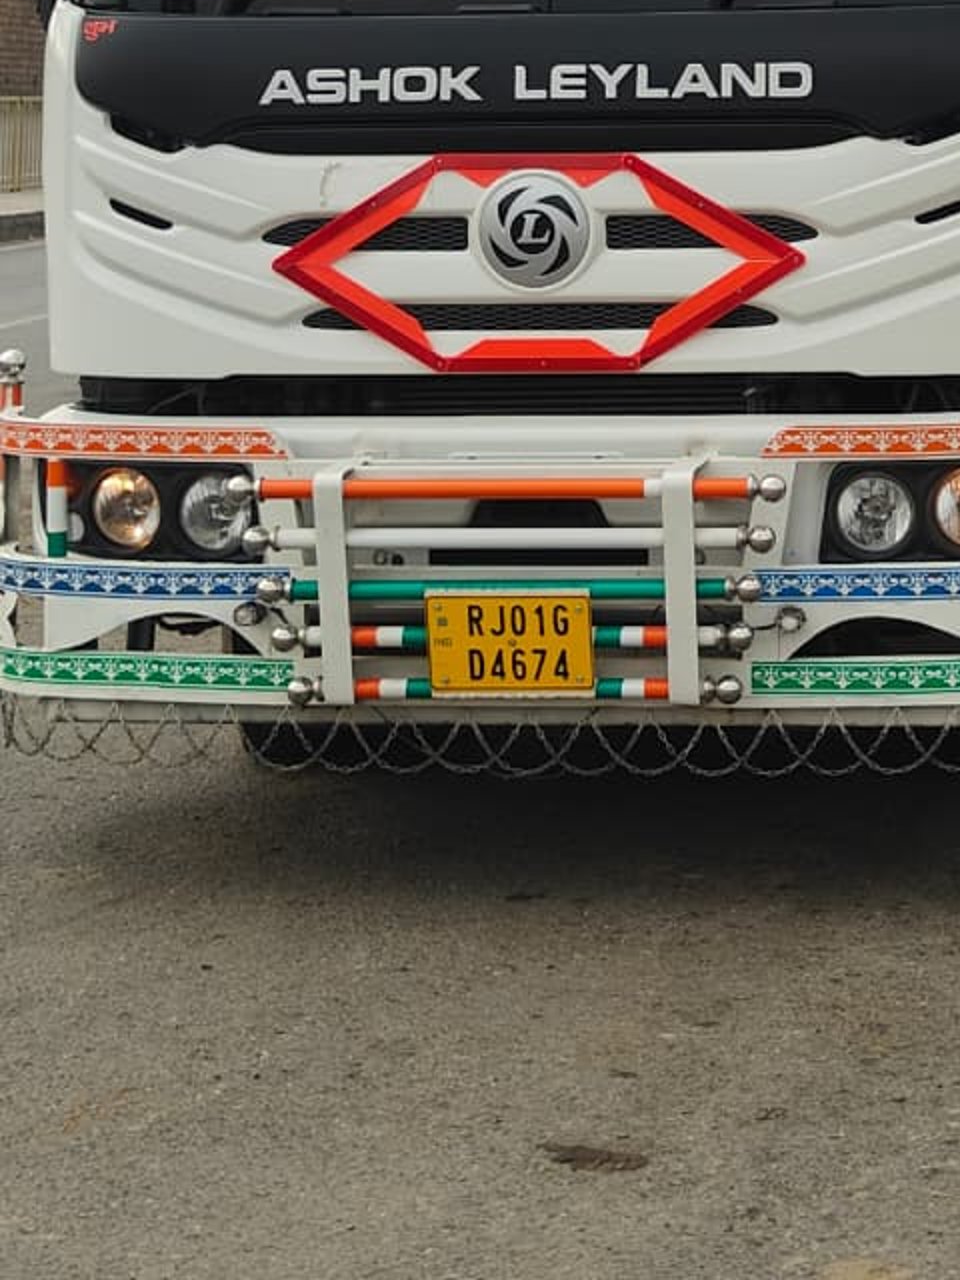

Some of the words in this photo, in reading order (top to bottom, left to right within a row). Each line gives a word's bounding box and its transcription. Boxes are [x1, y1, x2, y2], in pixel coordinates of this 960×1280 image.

[258, 65, 483, 106] ASHOK
[514, 62, 813, 101] LEYLAND
[516, 213, 551, 244] L
[467, 605, 569, 636] RJ01G
[468, 649, 569, 680] D4674
